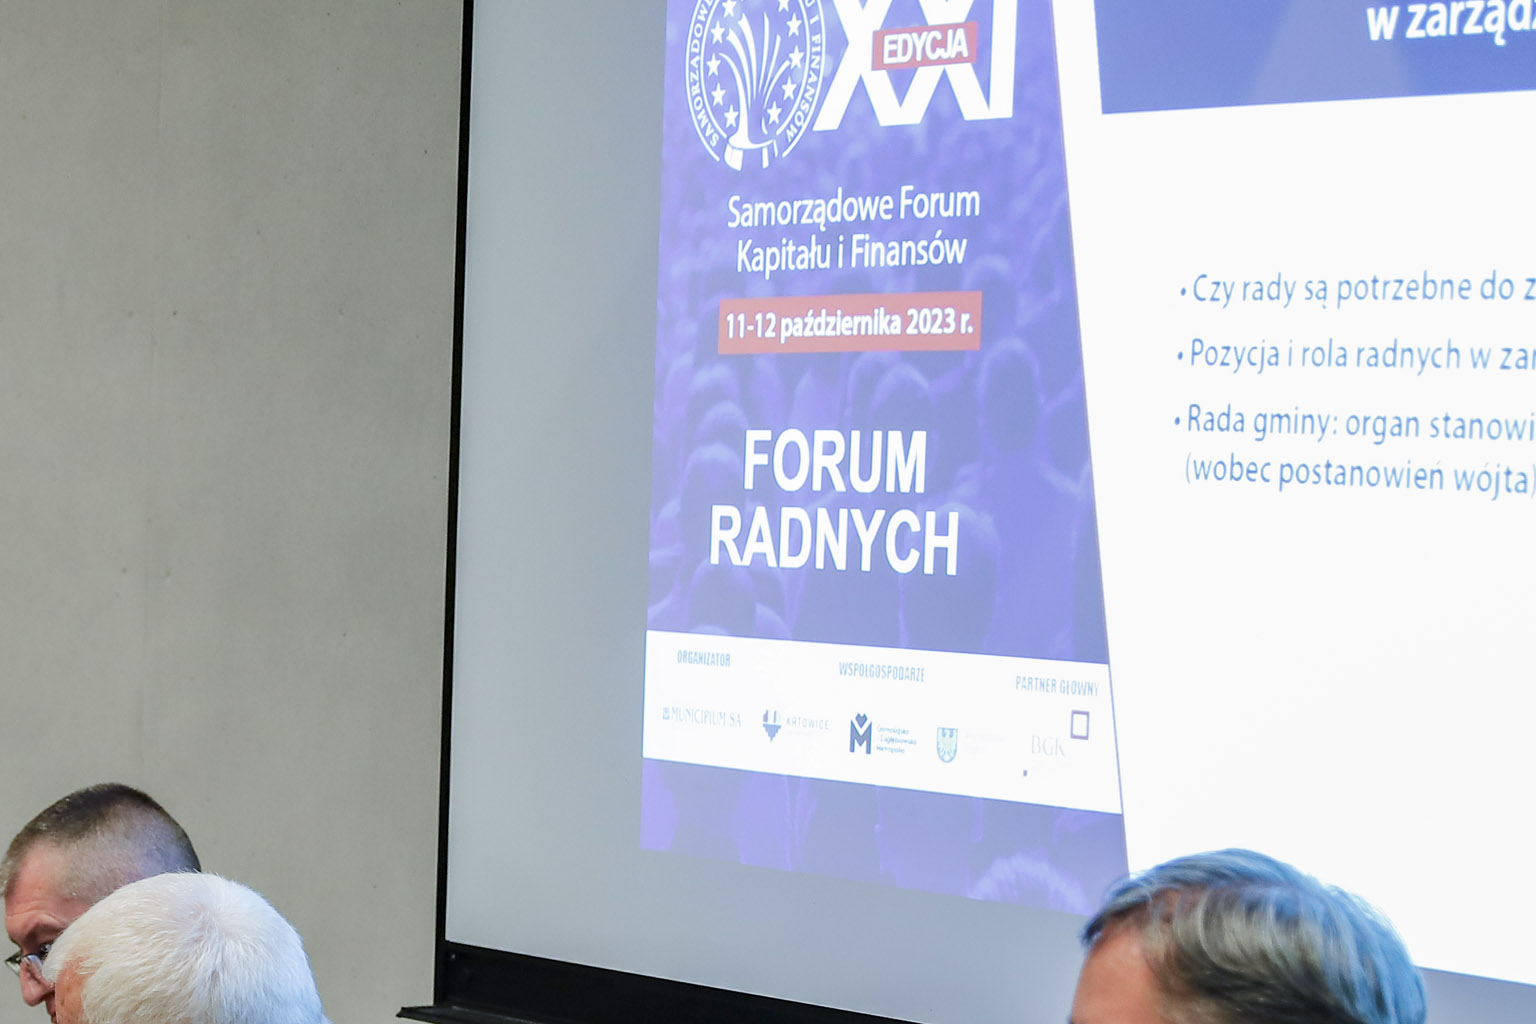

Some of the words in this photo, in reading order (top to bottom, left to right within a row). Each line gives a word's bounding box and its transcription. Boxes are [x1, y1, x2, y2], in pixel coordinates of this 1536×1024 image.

[1367, 6, 1399, 41] w
[1405, 0, 1536, 46] zarząd
[882, 28, 968, 66] EDYCJA
[727, 187, 894, 233] Samorządowe
[899, 184, 981, 220] Forum
[736, 234, 831, 280] Kapitału
[837, 234, 845, 269] i
[850, 229, 968, 268] Finansów
[1192, 273, 1236, 310] Czy
[1242, 271, 1298, 309] rady
[1304, 279, 1329, 309] są
[1336, 269, 1473, 310] potrzebne
[1479, 268, 1515, 301] do
[725, 312, 777, 340] 11-12
[780, 307, 902, 345] października
[906, 306, 957, 336] 2023
[960, 313, 974, 335] r.
[1190, 337, 1280, 376] Pozycja
[1287, 338, 1293, 367] i
[1301, 336, 1348, 368] rola
[1355, 337, 1461, 377] radnych
[1469, 347, 1492, 370] w
[1187, 402, 1246, 433] Rada
[1253, 405, 1338, 444] gminy:
[1345, 414, 1420, 446] organ
[1429, 411, 1536, 442] stanowi
[743, 427, 928, 495] FORUM
[1185, 451, 1272, 484] (wobec
[1278, 458, 1445, 493] postanowień
[709, 504, 960, 577] RADNYCH
[676, 649, 732, 668] ORGANIZATOR
[1015, 675, 1058, 695] PARTNER
[670, 706, 726, 727] MUNICIPIUM
[786, 716, 831, 730] KATOWICE
